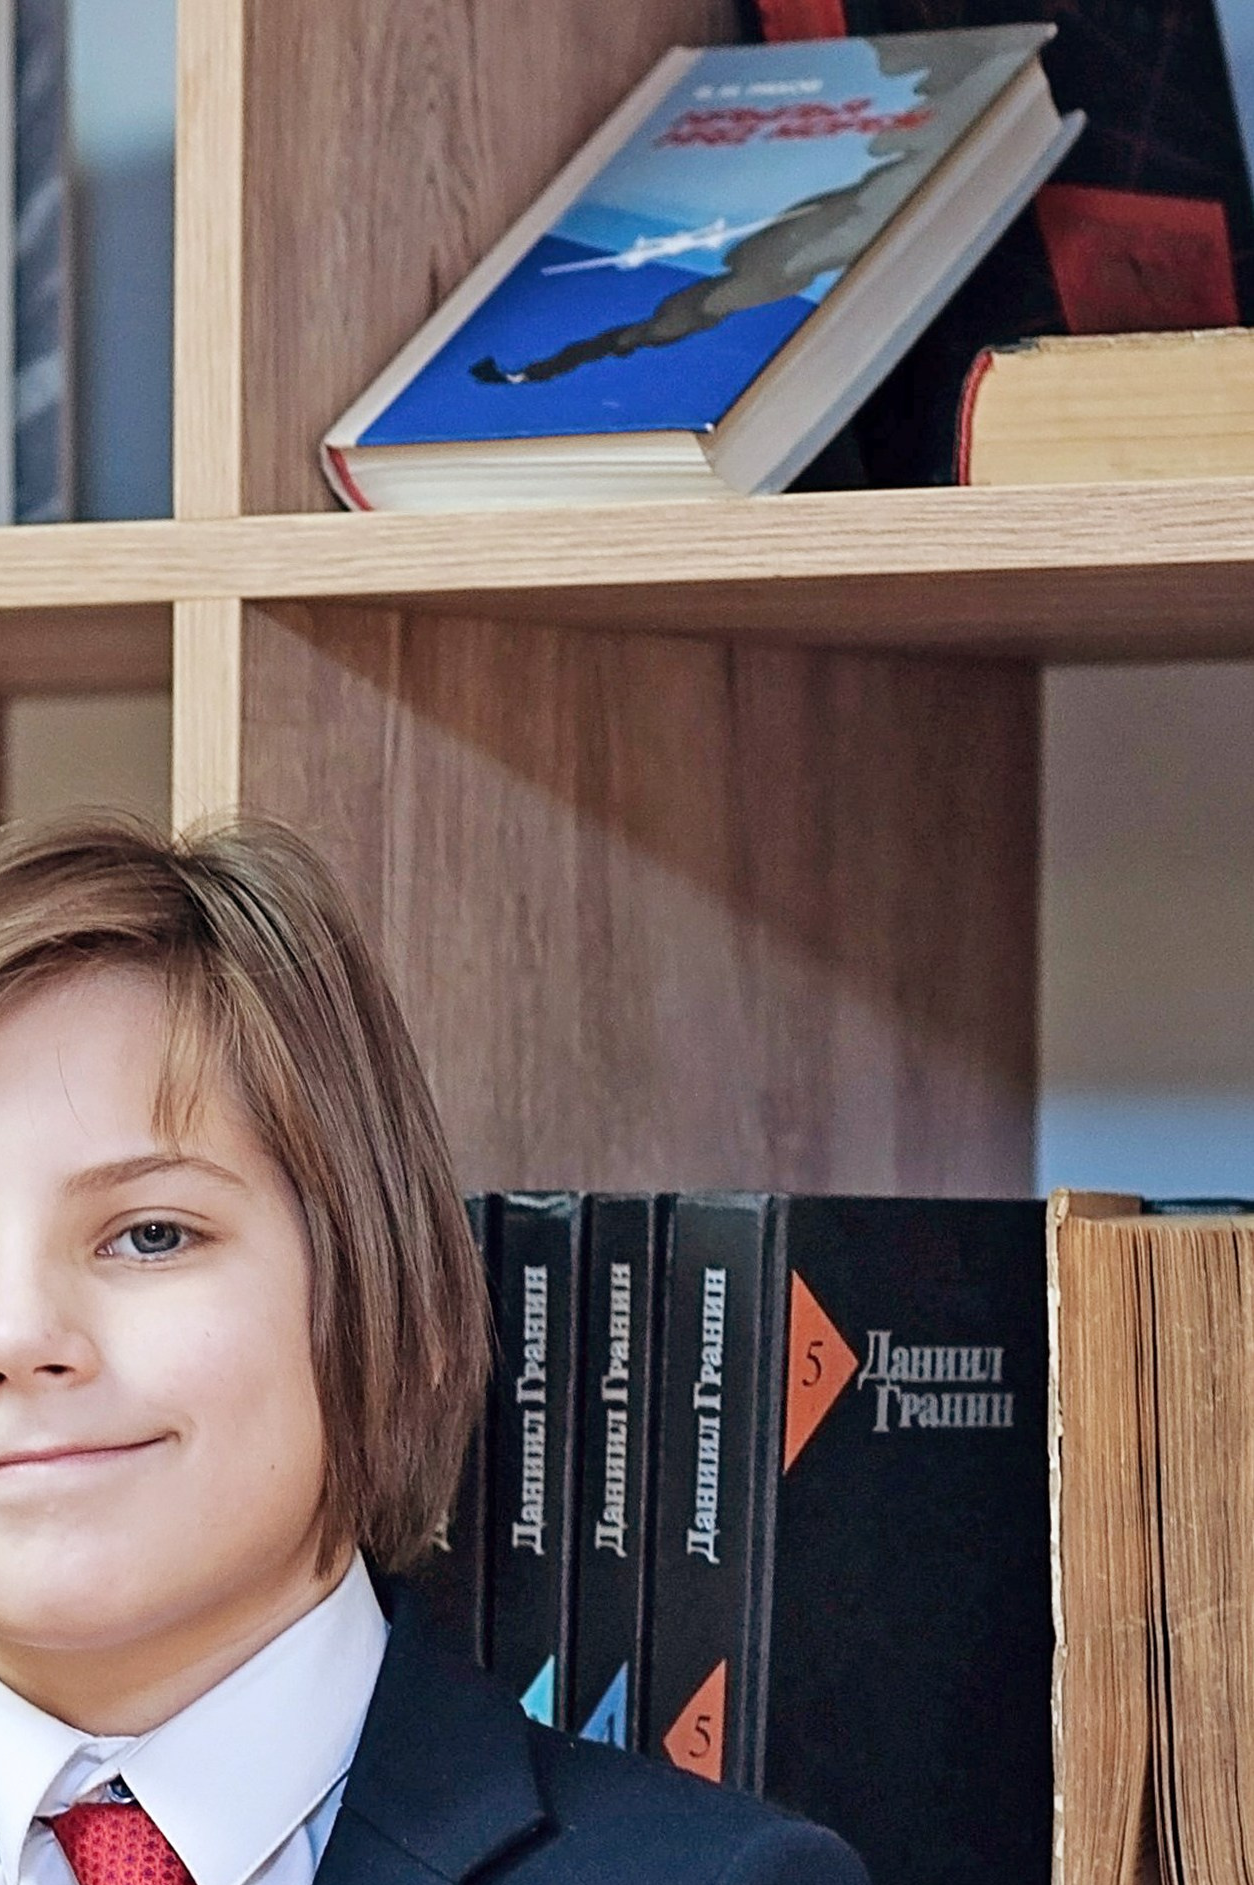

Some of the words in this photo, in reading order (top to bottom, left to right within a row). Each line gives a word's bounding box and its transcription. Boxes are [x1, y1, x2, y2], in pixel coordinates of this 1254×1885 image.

[515, 1264, 548, 1404] Гранин
[601, 1262, 632, 1404] Гранин
[693, 1267, 727, 1410] Гранин
[801, 1340, 824, 1388] 5
[857, 1329, 1005, 1391] Даниил
[872, 1384, 1015, 1433] Гранин
[512, 1408, 546, 1556] Даниил
[595, 1408, 628, 1558] Даниил
[686, 1414, 721, 1564] Даниил
[689, 1714, 712, 1758] 5
